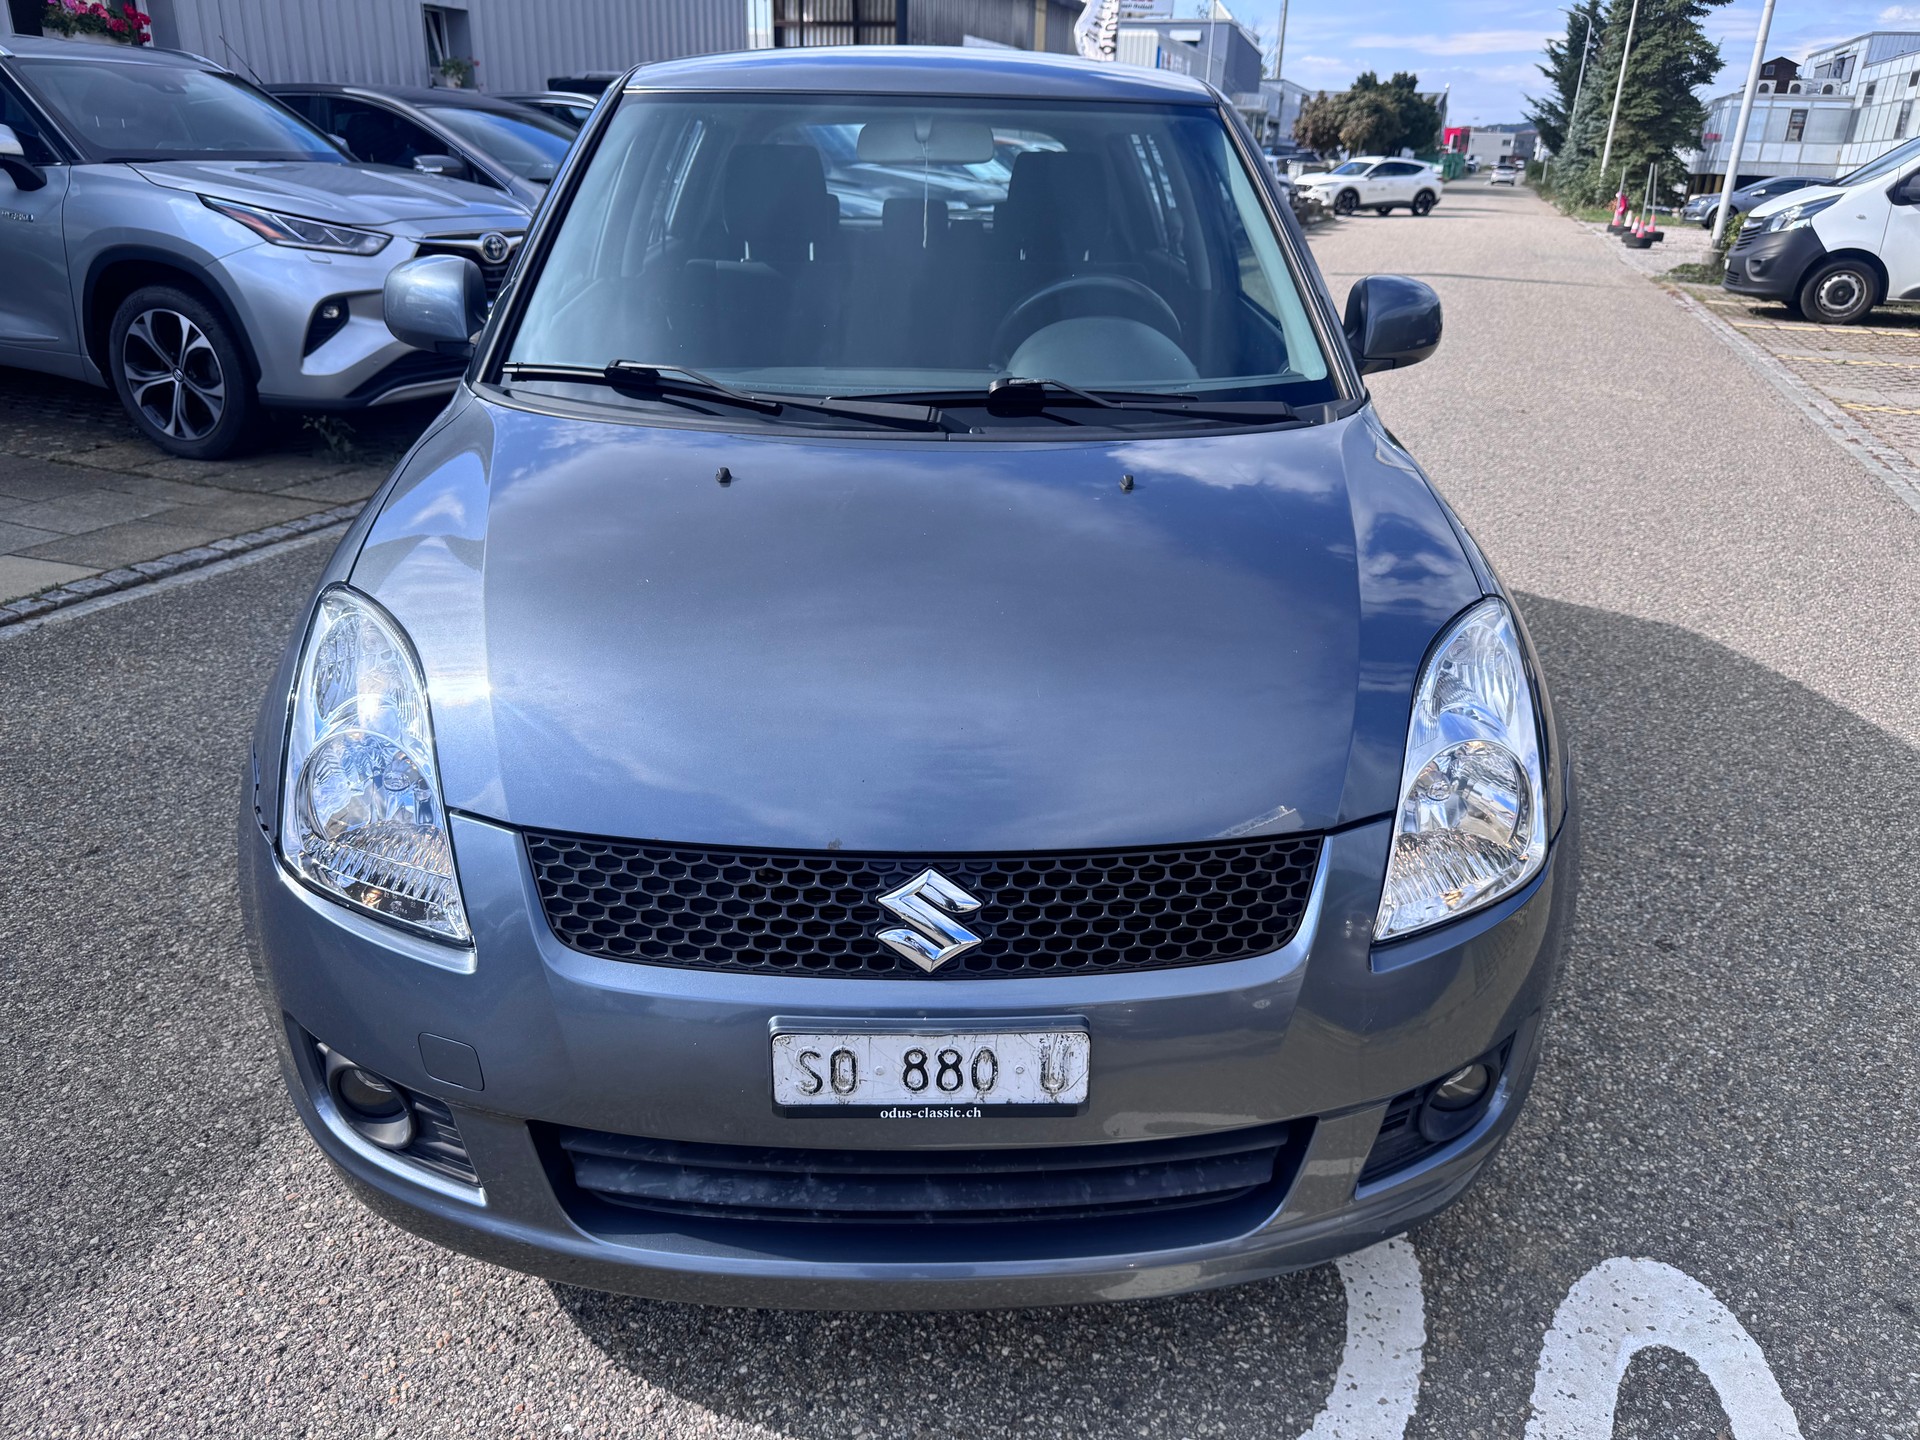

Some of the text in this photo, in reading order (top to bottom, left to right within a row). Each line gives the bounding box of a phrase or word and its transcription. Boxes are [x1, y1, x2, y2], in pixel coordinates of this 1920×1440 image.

[797, 1042, 1069, 1094] SO 880 U
[880, 1107, 981, 1119] odus-classic.ch
